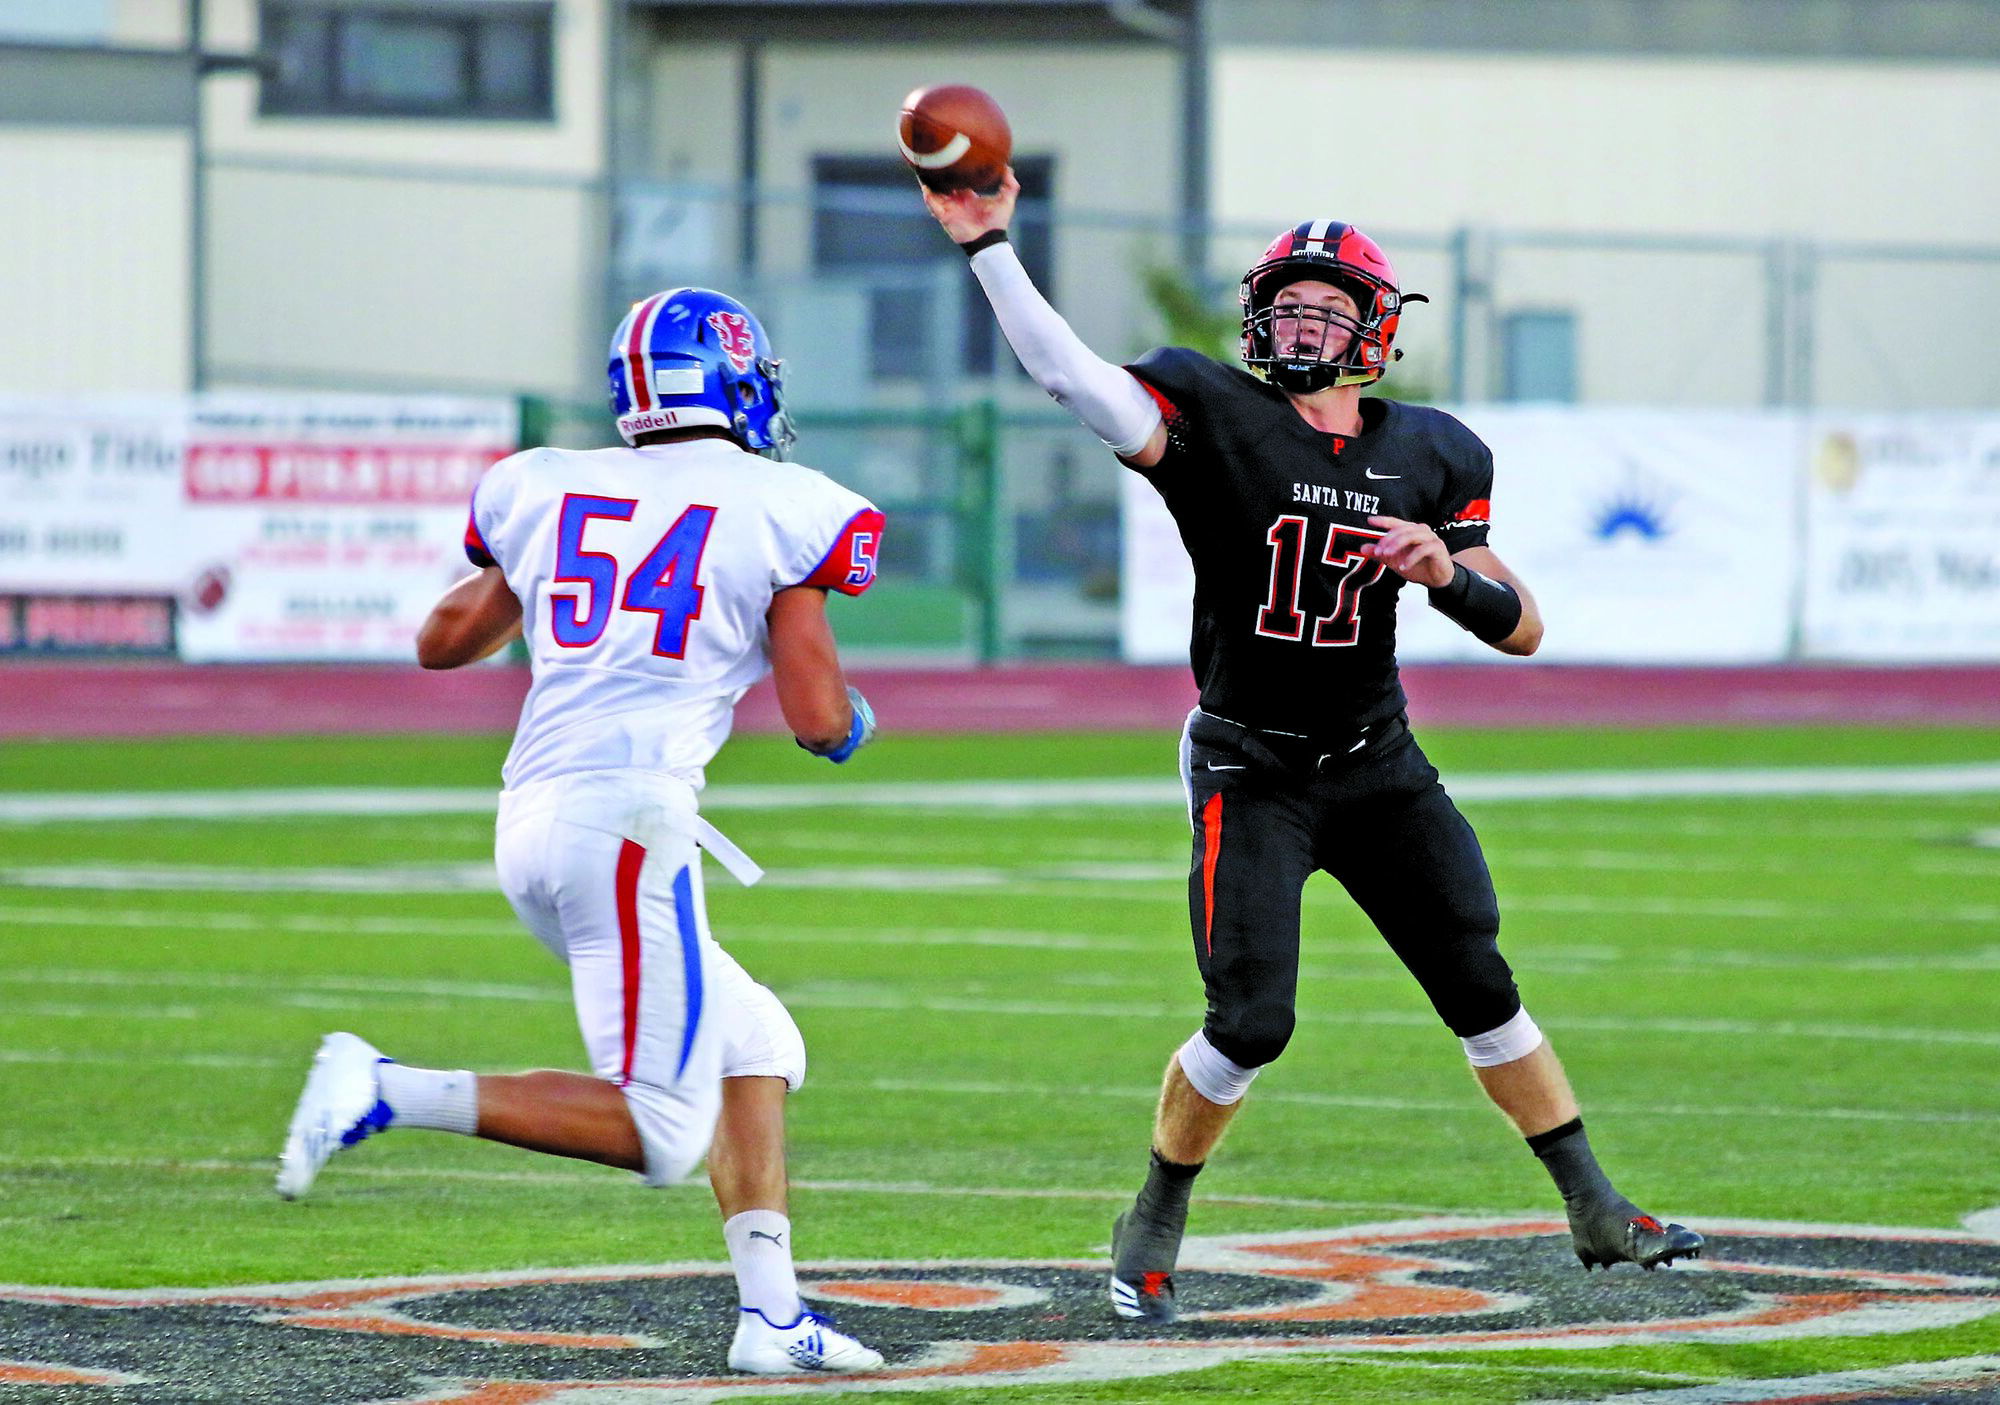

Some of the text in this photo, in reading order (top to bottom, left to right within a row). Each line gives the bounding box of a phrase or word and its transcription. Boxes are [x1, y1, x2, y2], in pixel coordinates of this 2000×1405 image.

[620, 411, 678, 432] Riddell
[1333, 438, 1345, 455] P
[1293, 482, 1380, 515] SANTA YNEZ
[550, 492, 718, 661] 54
[844, 532, 882, 587] 5
[1255, 514, 1390, 647] 17
